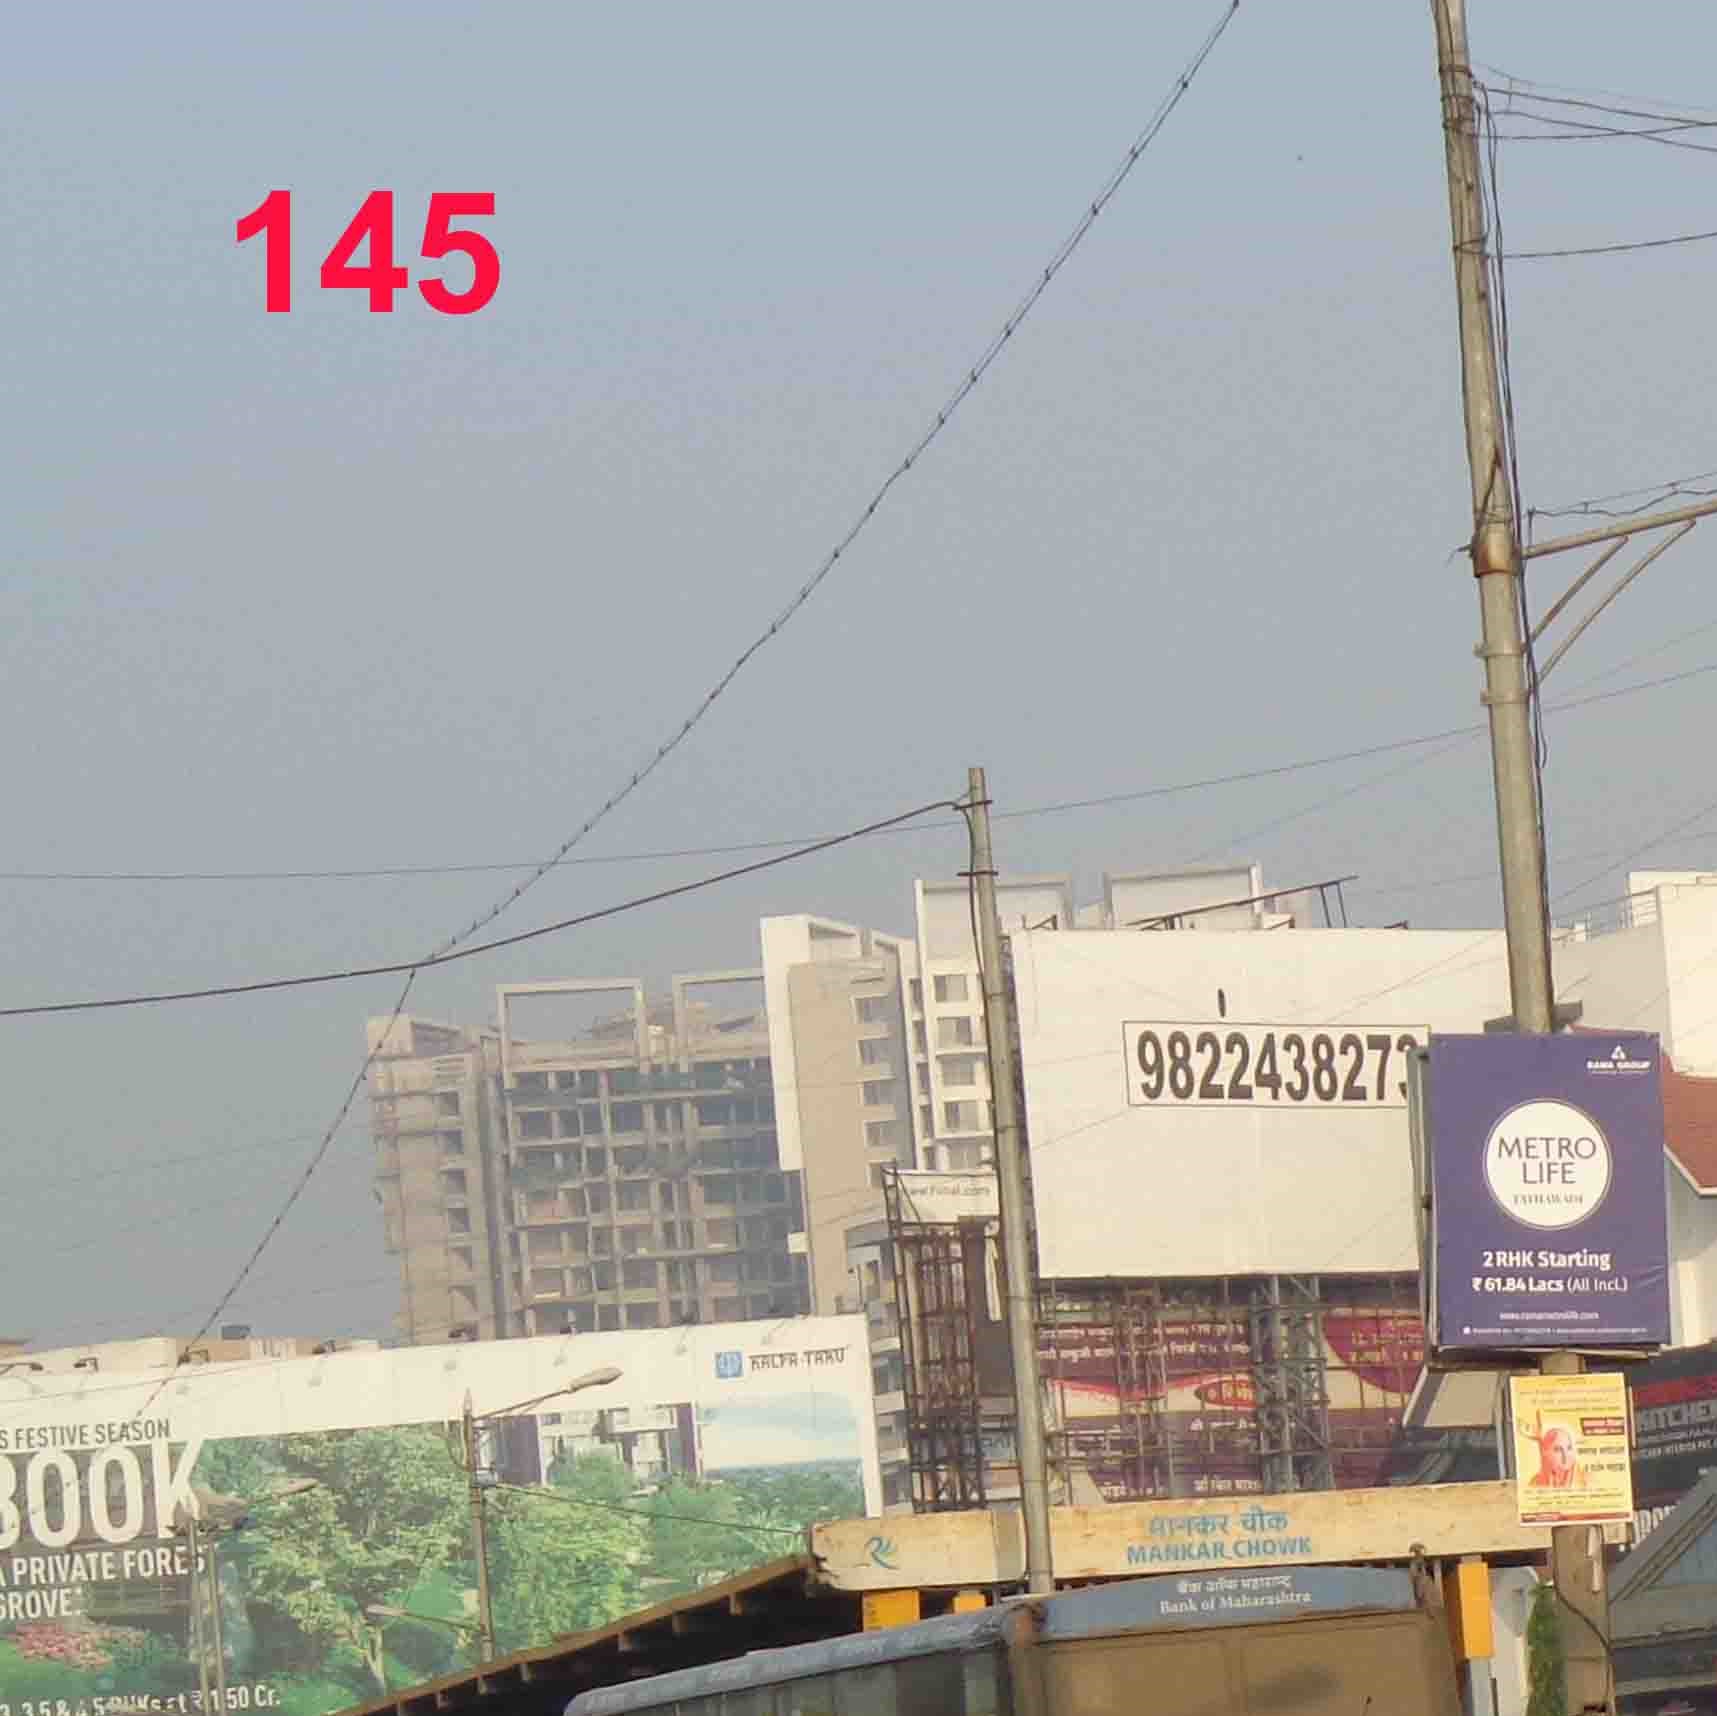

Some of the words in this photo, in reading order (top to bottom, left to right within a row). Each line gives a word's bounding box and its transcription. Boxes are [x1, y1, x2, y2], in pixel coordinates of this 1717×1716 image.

[1498, 1137, 1597, 1160] METRO
[1522, 1162, 1577, 1184] LIFE
[1537, 1248, 1612, 1271] Starting
[1528, 1278, 1564, 1292] Lacs
[15, 1425, 89, 1449] FESTIVE
[95, 1418, 171, 1443] SEASON
[1127, 1542, 1225, 1565] MANKAR
[1232, 1536, 1313, 1558] CHOWK
[12, 1550, 117, 1585] PRIVATE
[1160, 1600, 1198, 1614] Bank
[1200, 1598, 1216, 1611] of
[1219, 1591, 1313, 1610] Maharashtra
[254, 1684, 282, 1707] Cr.
